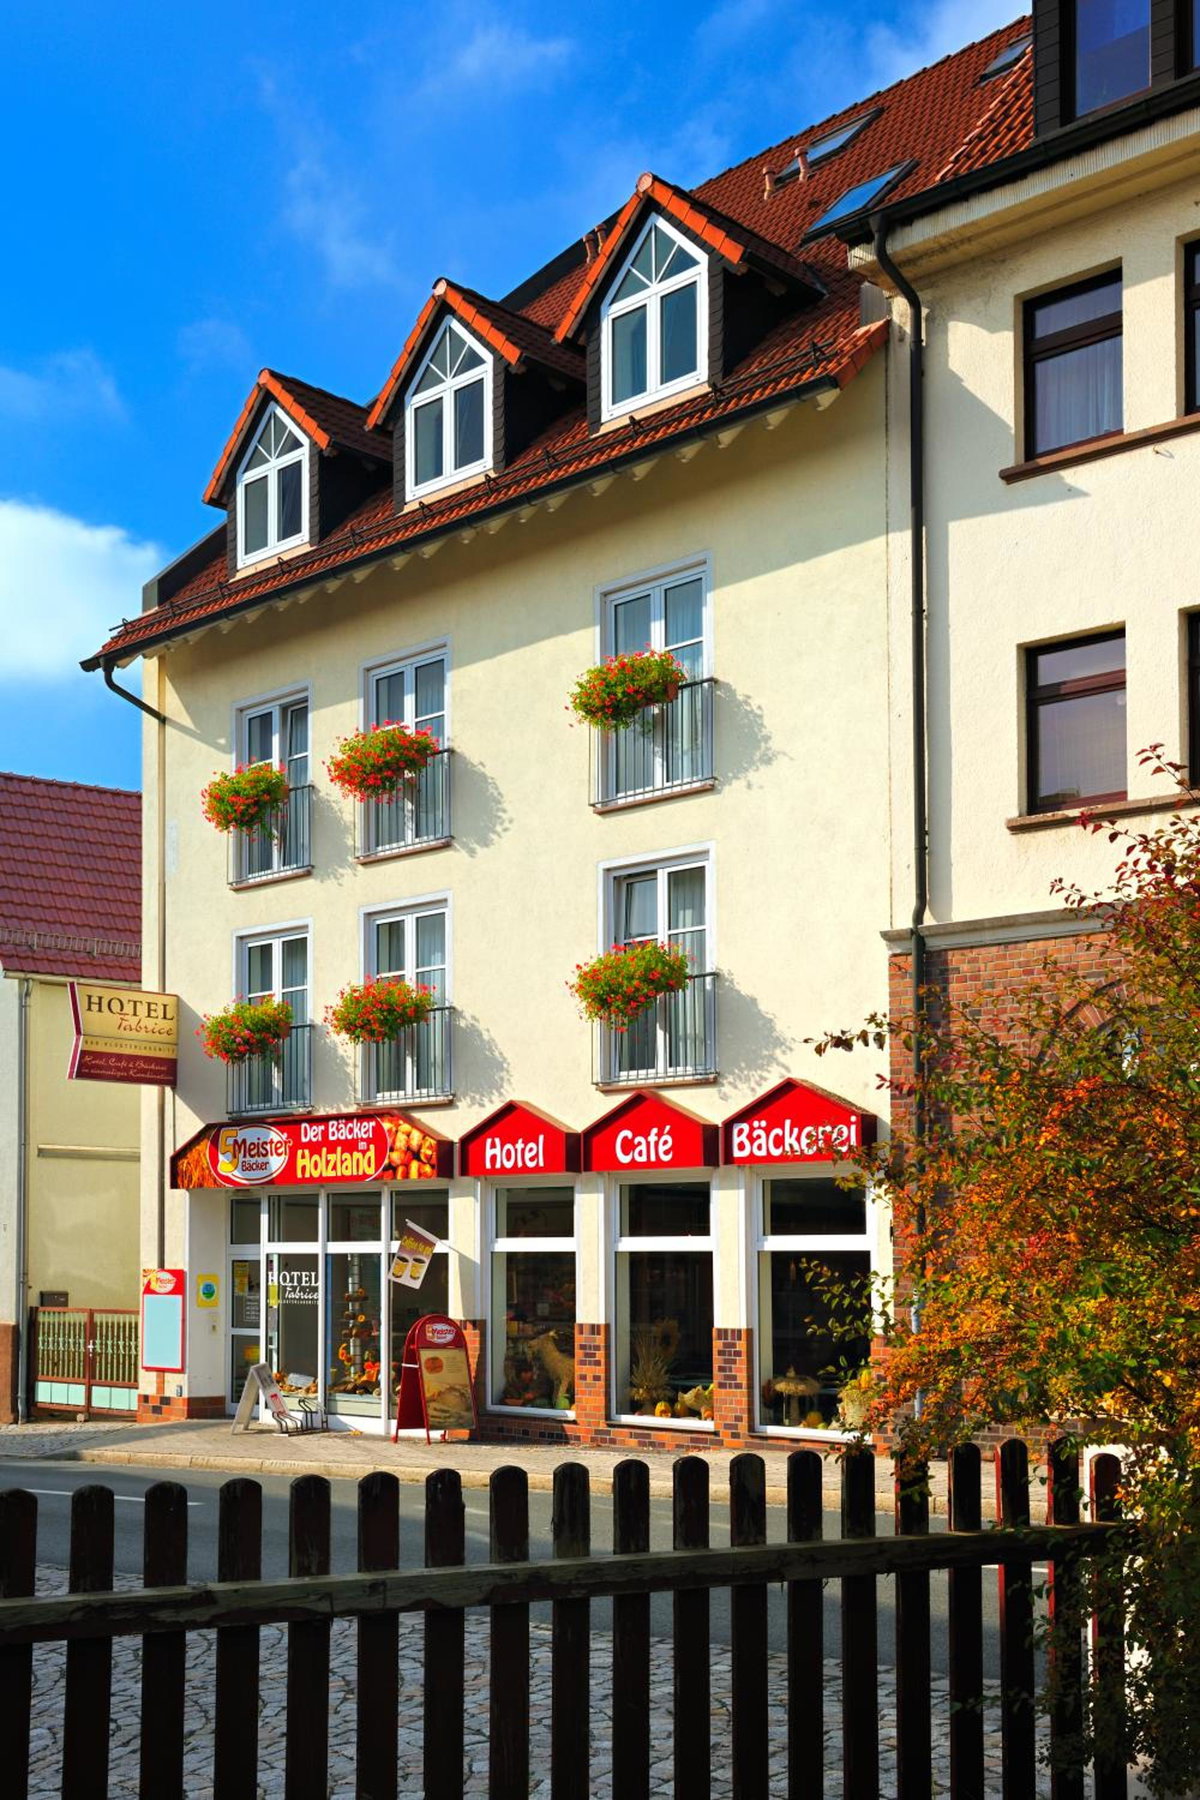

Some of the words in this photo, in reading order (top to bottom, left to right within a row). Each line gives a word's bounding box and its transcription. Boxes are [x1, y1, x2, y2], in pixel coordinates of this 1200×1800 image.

[86, 994, 175, 1021] HOTEL
[301, 1122, 325, 1142] Der
[328, 1118, 376, 1141] Bäcker
[732, 1115, 857, 1158] Bäckerei
[233, 1137, 293, 1159] Meister
[358, 1139, 367, 1150] im
[485, 1134, 544, 1169] Hotel
[615, 1125, 673, 1164] Café
[241, 1159, 270, 1172] Bäcker
[296, 1144, 375, 1179] Holzland
[268, 1271, 320, 1286] HOTEL
